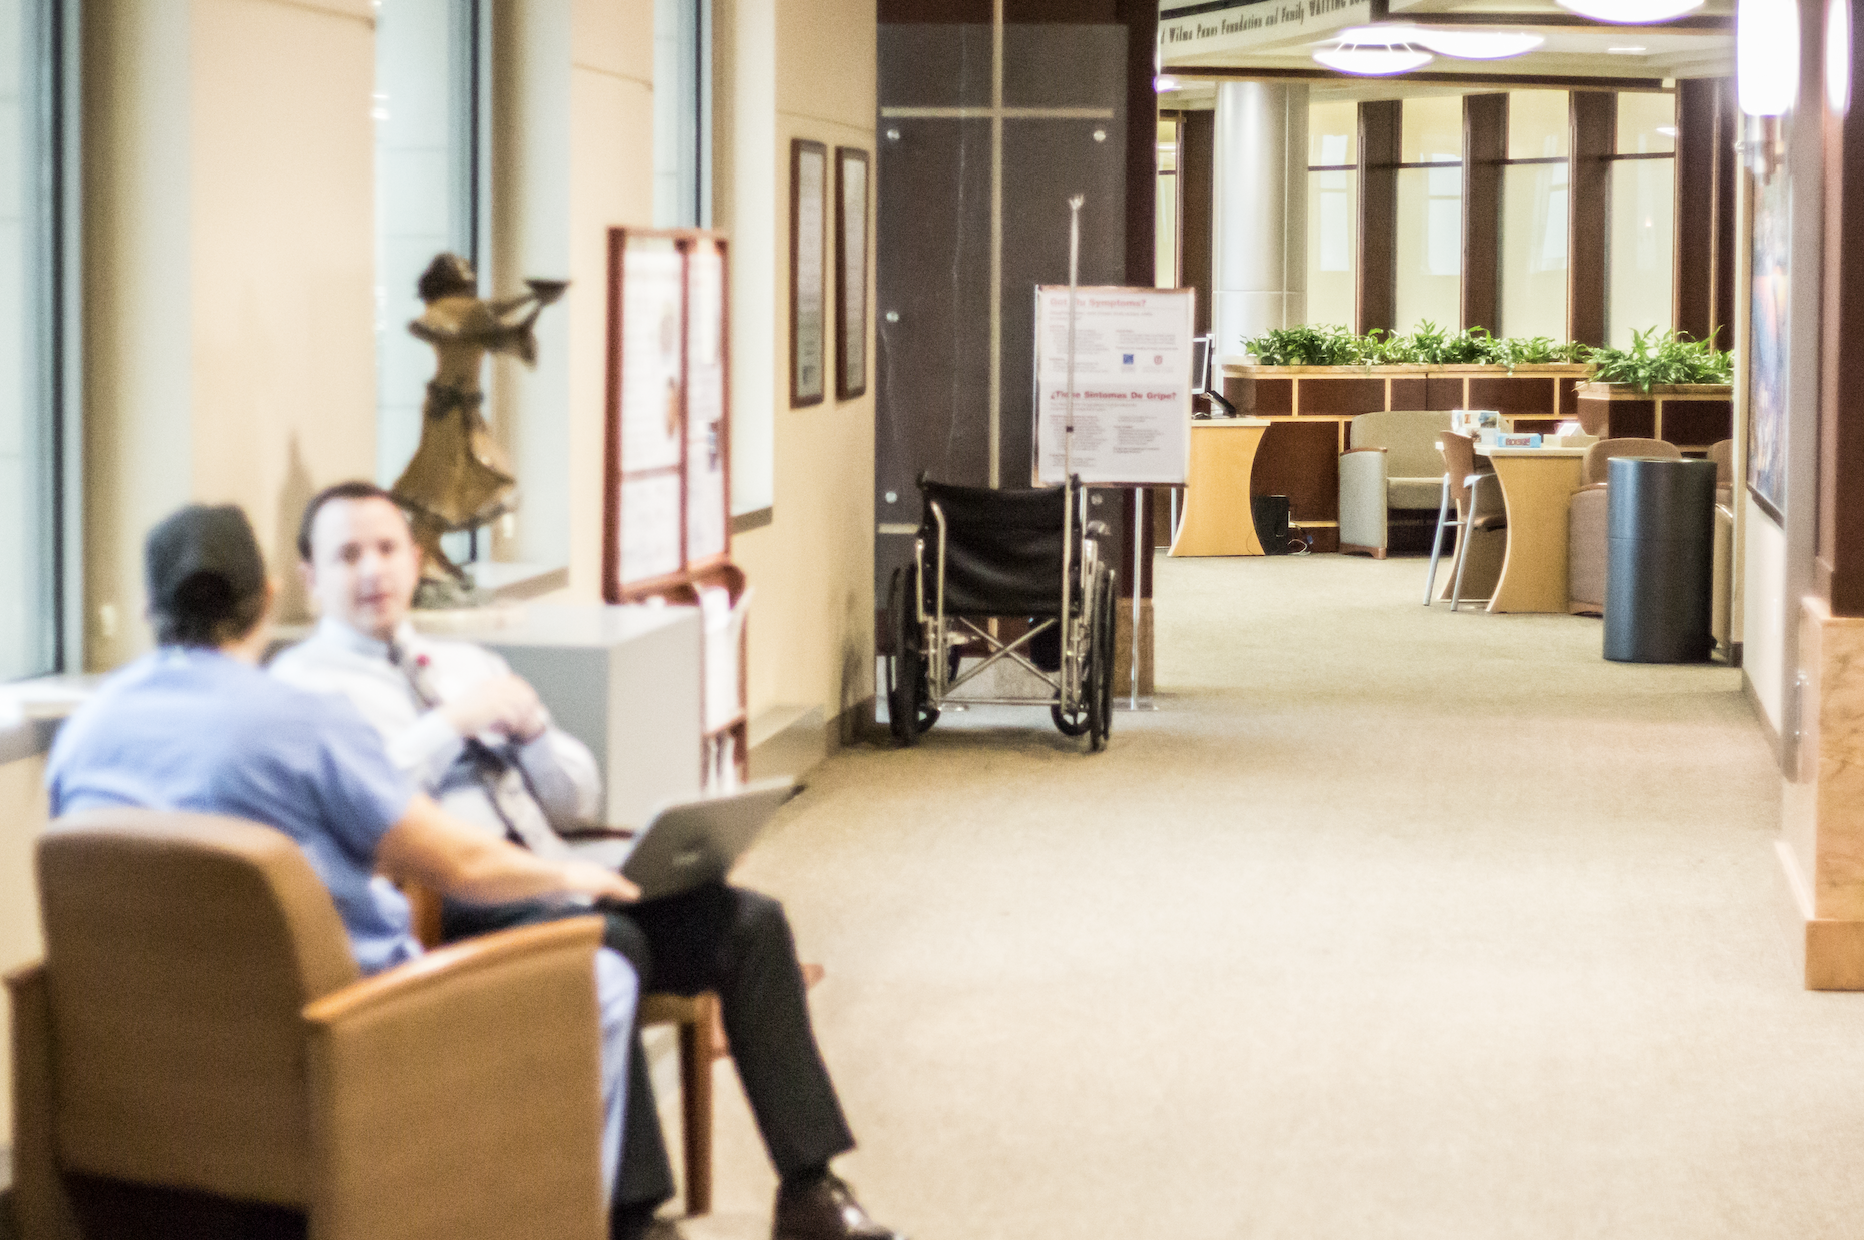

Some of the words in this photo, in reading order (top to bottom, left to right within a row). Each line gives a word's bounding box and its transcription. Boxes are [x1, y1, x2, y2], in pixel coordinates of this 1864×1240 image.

[1169, 25, 1193, 43] Wilma
[1221, 14, 1263, 35] Foundation
[1265, 6, 1279, 27] and
[1281, 1, 1305, 25] Family
[1089, 298, 1147, 308] Symptoms?
[1084, 391, 1128, 399] Sintomas
[1130, 391, 1143, 399] De
[1146, 391, 1177, 401] Gripe?
